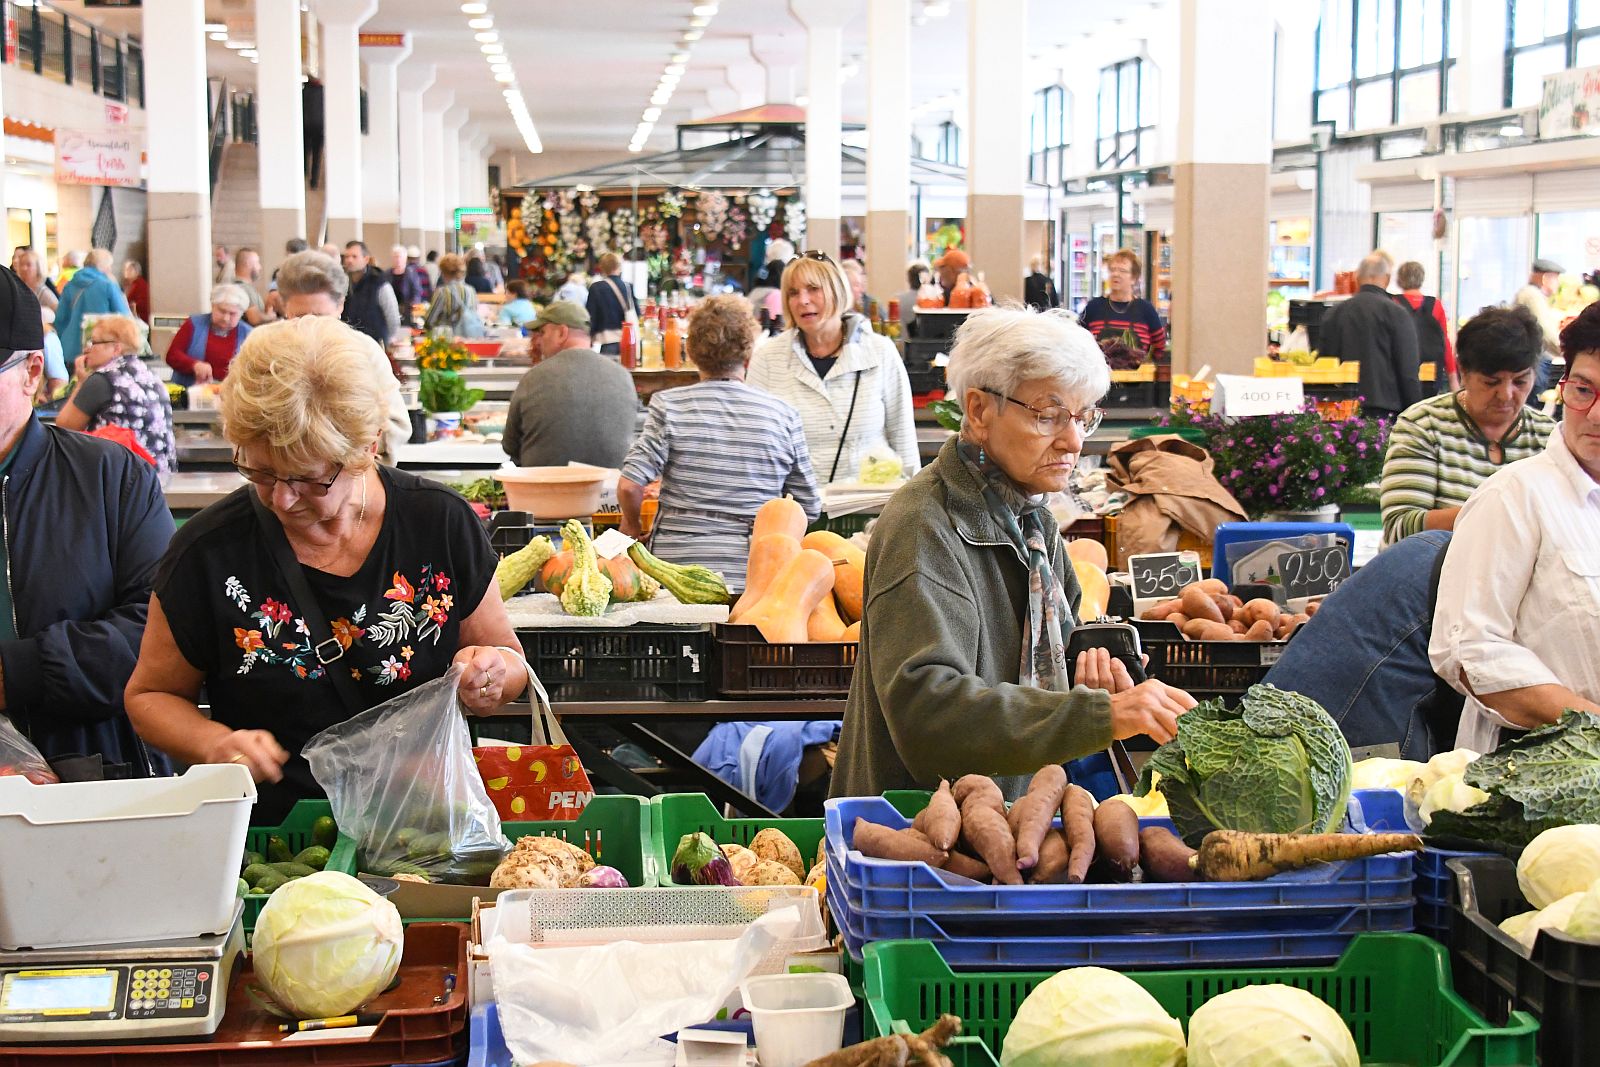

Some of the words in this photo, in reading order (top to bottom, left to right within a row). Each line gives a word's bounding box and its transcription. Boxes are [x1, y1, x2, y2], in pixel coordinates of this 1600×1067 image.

[1240, 391, 1271, 402] 400
[1276, 391, 1291, 401] Ft
[1135, 563, 1193, 594] 350
[1285, 549, 1344, 587] 250
